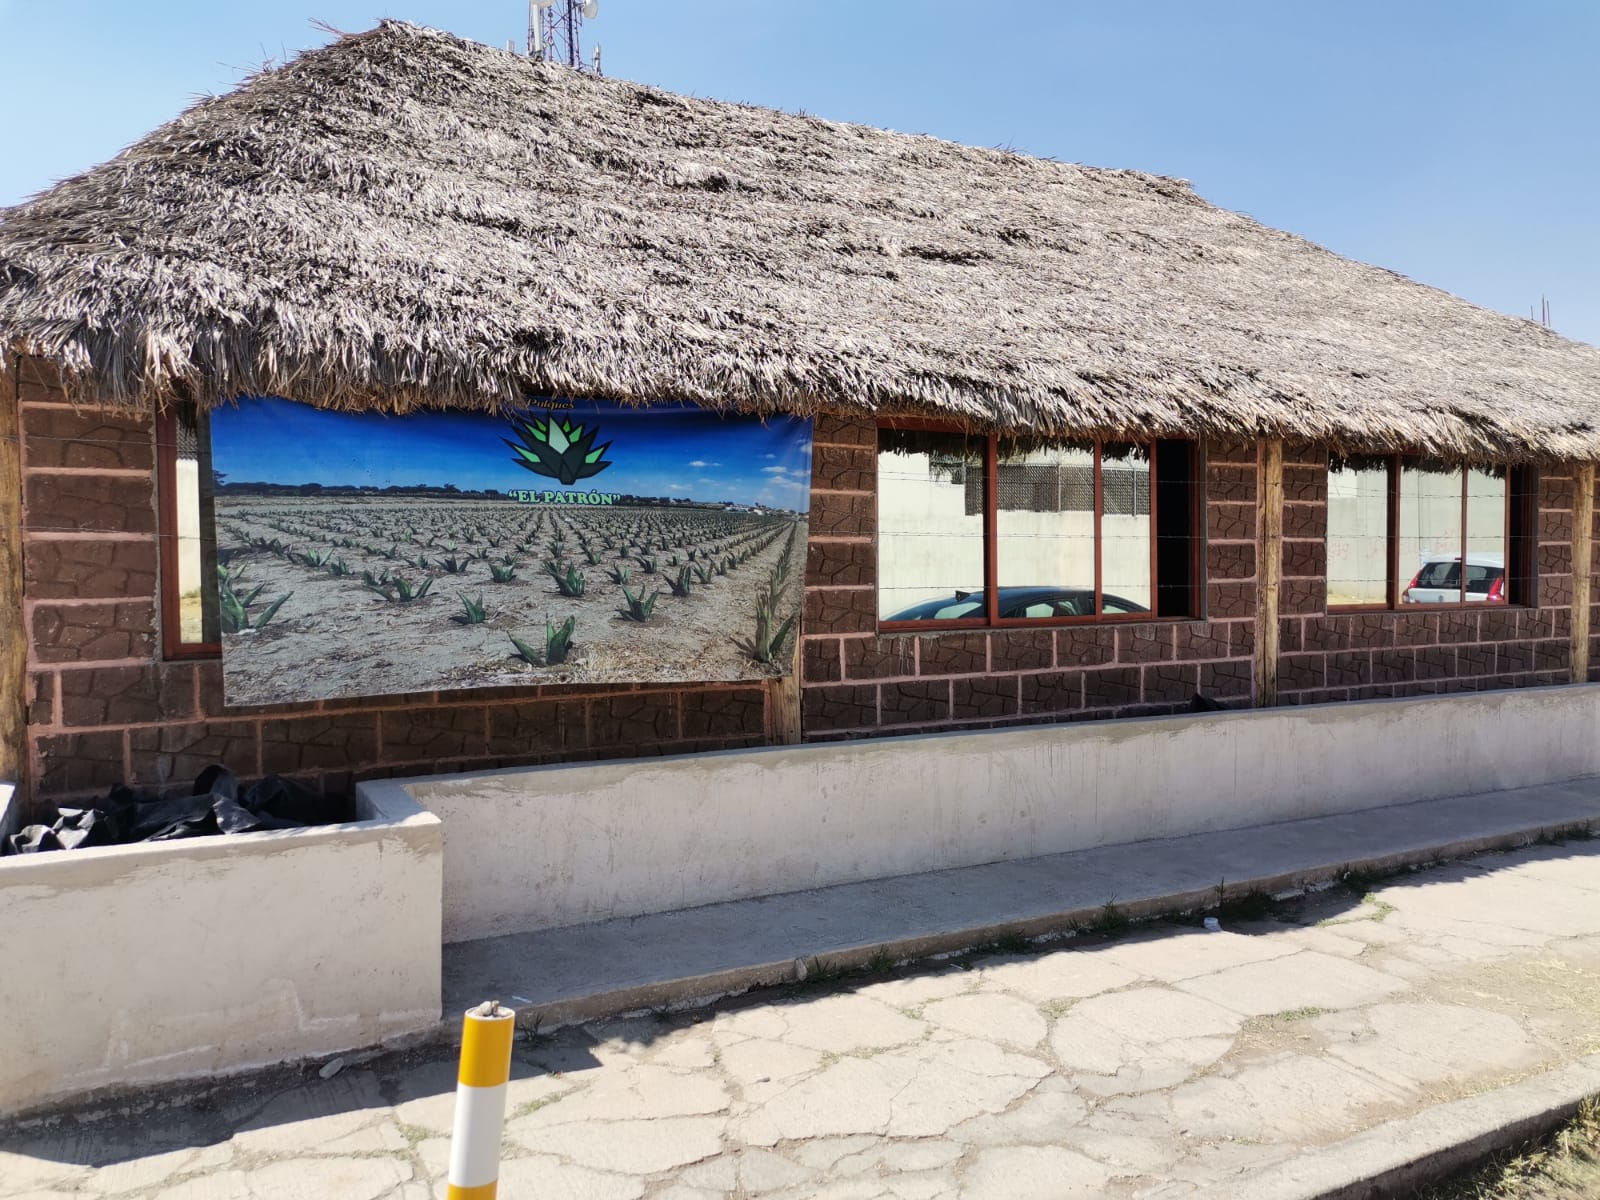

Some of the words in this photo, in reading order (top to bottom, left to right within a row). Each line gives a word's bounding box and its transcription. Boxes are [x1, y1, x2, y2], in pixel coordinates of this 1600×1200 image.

[526, 398, 575, 411] Pulques
[508, 489, 541, 503] “EL
[543, 487, 621, 505] PATRÓN”
